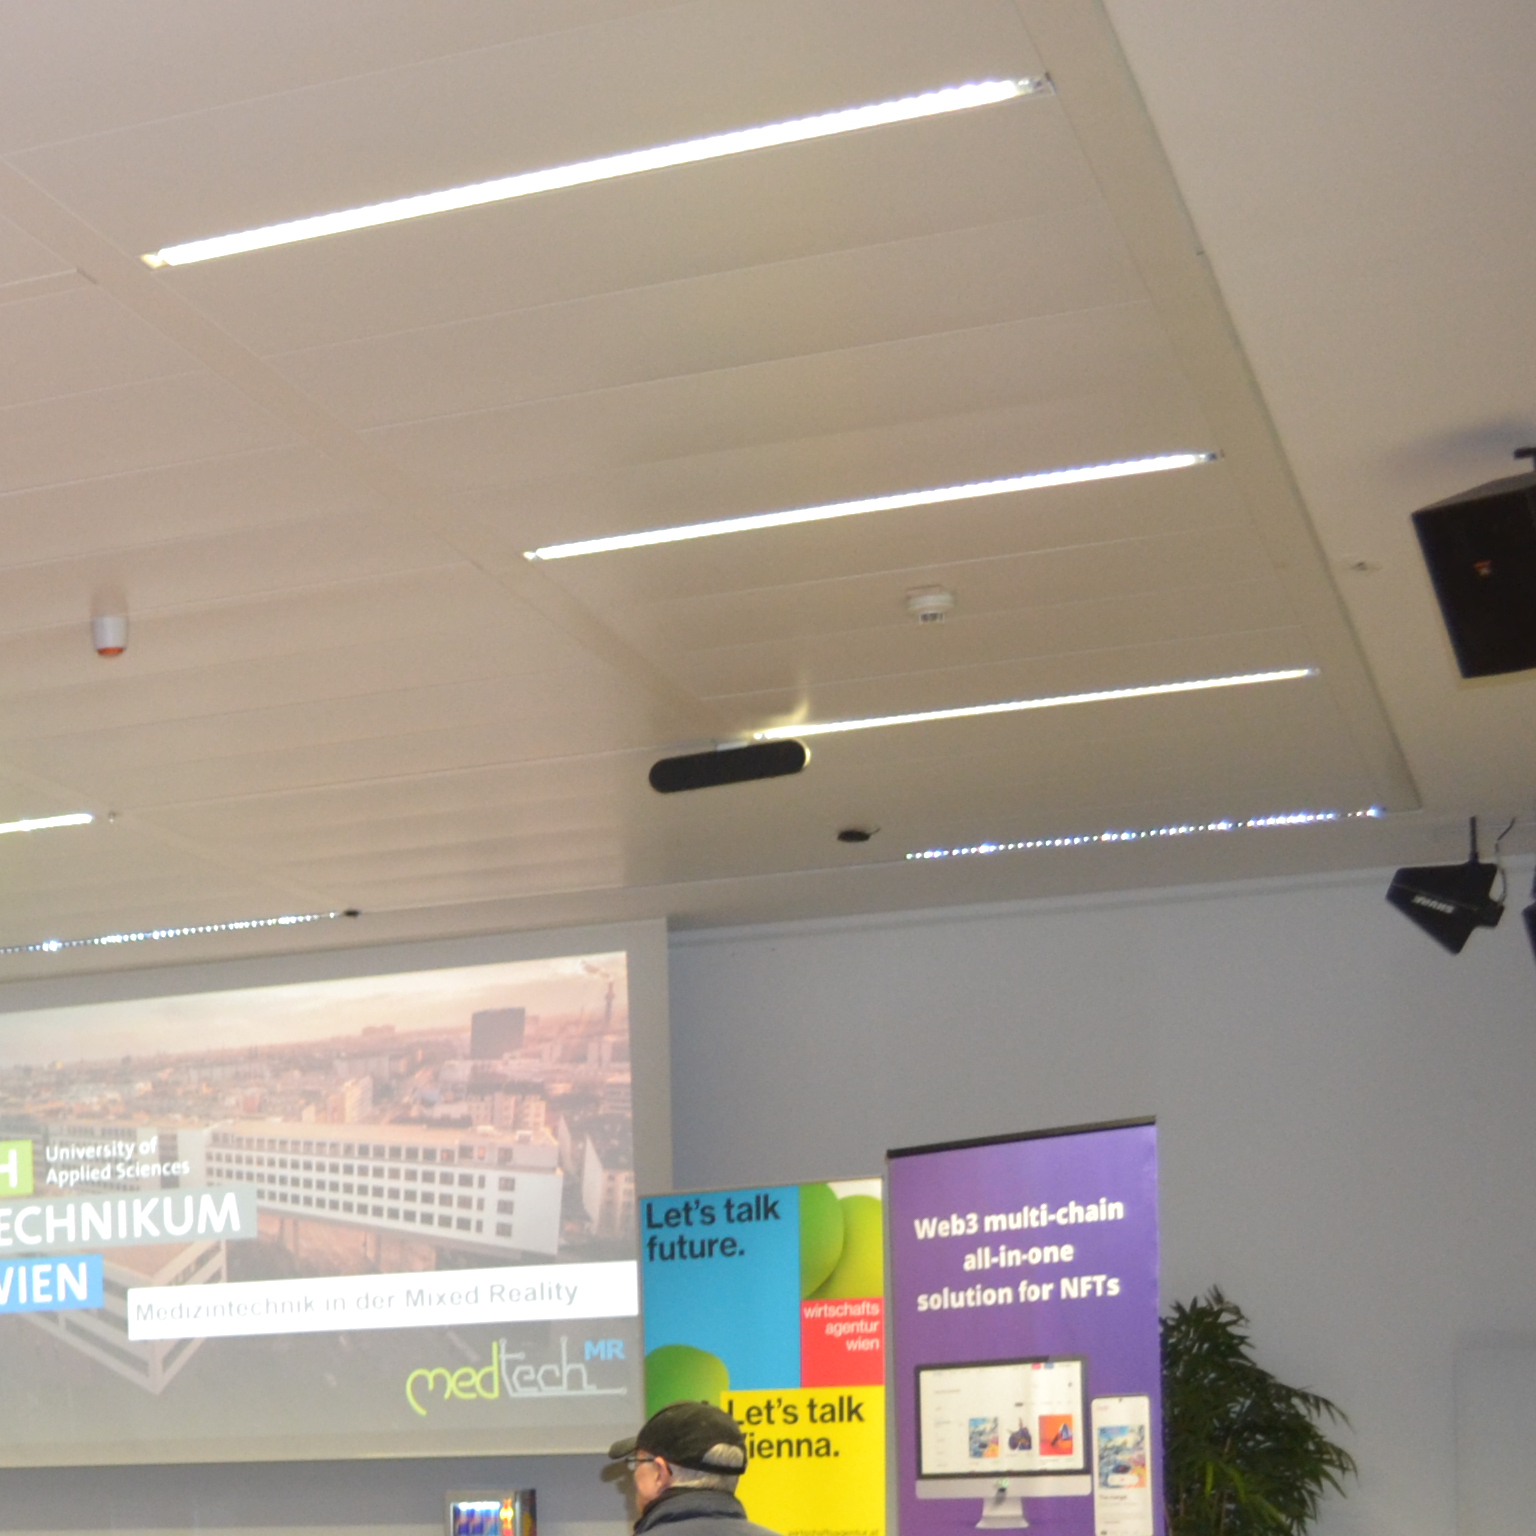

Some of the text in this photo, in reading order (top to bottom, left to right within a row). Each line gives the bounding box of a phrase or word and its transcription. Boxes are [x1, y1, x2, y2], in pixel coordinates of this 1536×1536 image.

[46, 1135, 159, 1162] University of
[46, 1159, 190, 1187] Applied Sciences
[646, 1193, 781, 1230] Let's talk
[913, 1197, 1125, 1240] Web3 multi-chain
[647, 1235, 746, 1262] future.
[963, 1243, 1075, 1272] all-in-one
[135, 1281, 578, 1322] Medizintechnik in der Mixed Reality
[917, 1274, 1121, 1312] solution for NFTs
[803, 1300, 880, 1319] wirtschafts
[824, 1319, 880, 1339] agentur
[584, 1339, 626, 1361] MR
[845, 1337, 880, 1352] wien
[728, 1395, 866, 1425] Let's talk
[743, 1432, 840, 1460] ienna.
